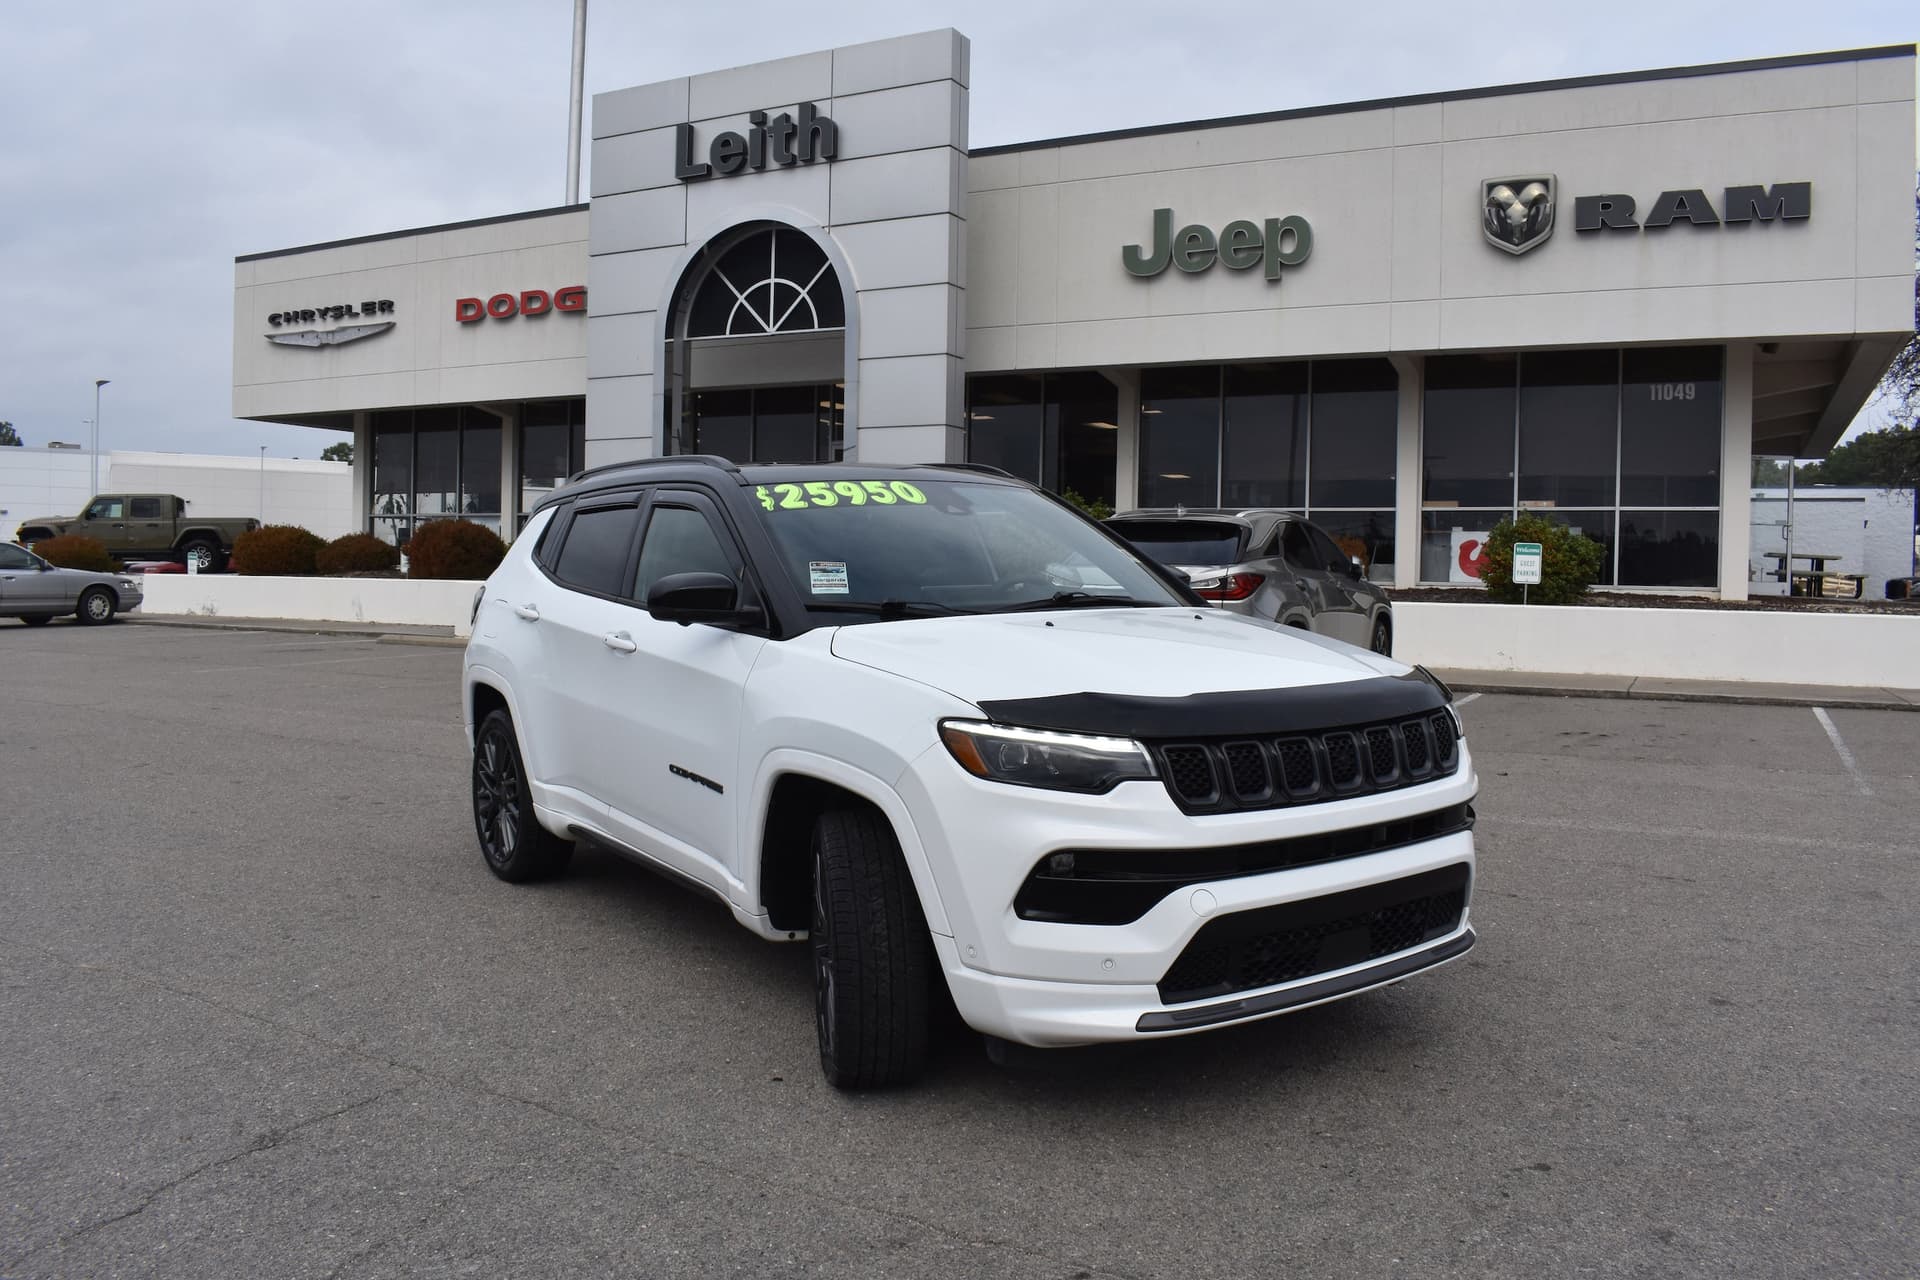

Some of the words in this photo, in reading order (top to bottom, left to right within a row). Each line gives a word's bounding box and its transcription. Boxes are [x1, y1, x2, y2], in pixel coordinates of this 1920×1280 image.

[675, 101, 839, 182] Leith
[1575, 181, 1811, 232] RAM
[1122, 208, 1314, 281] Jeep
[268, 299, 395, 326] CHRYSLER
[1648, 383, 1696, 401] 11049
[756, 480, 928, 512] $25950
